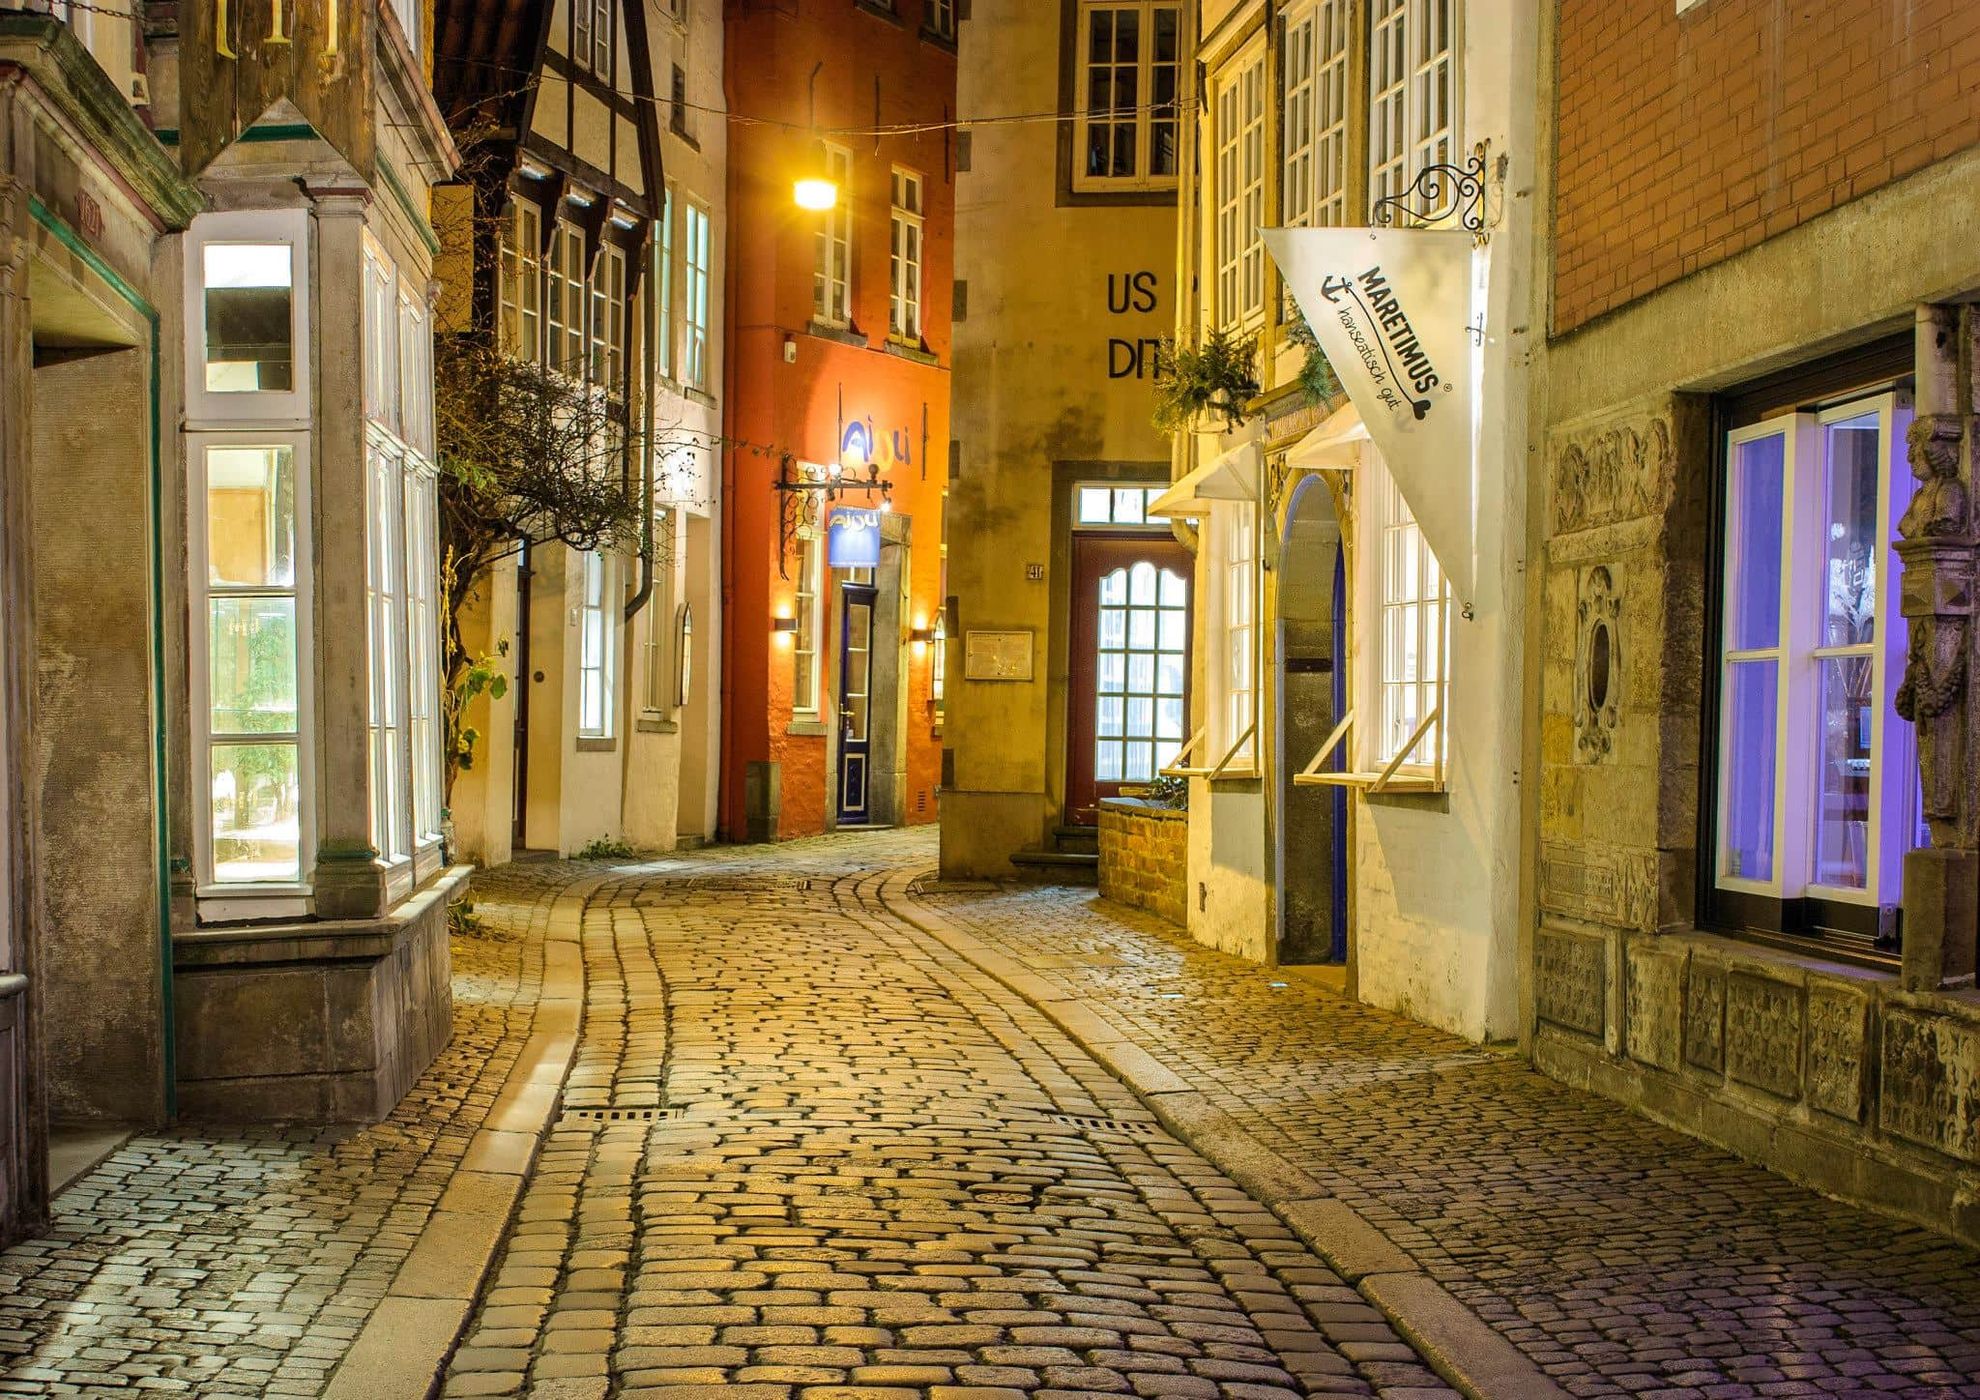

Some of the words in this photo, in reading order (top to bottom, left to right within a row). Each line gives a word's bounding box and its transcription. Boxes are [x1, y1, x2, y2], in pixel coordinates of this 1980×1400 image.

[1108, 271, 1158, 314] US
[1358, 266, 1439, 394] MARETIMUS
[1337, 306, 1387, 385] hanseatisch
[1376, 387, 1401, 412] gut
